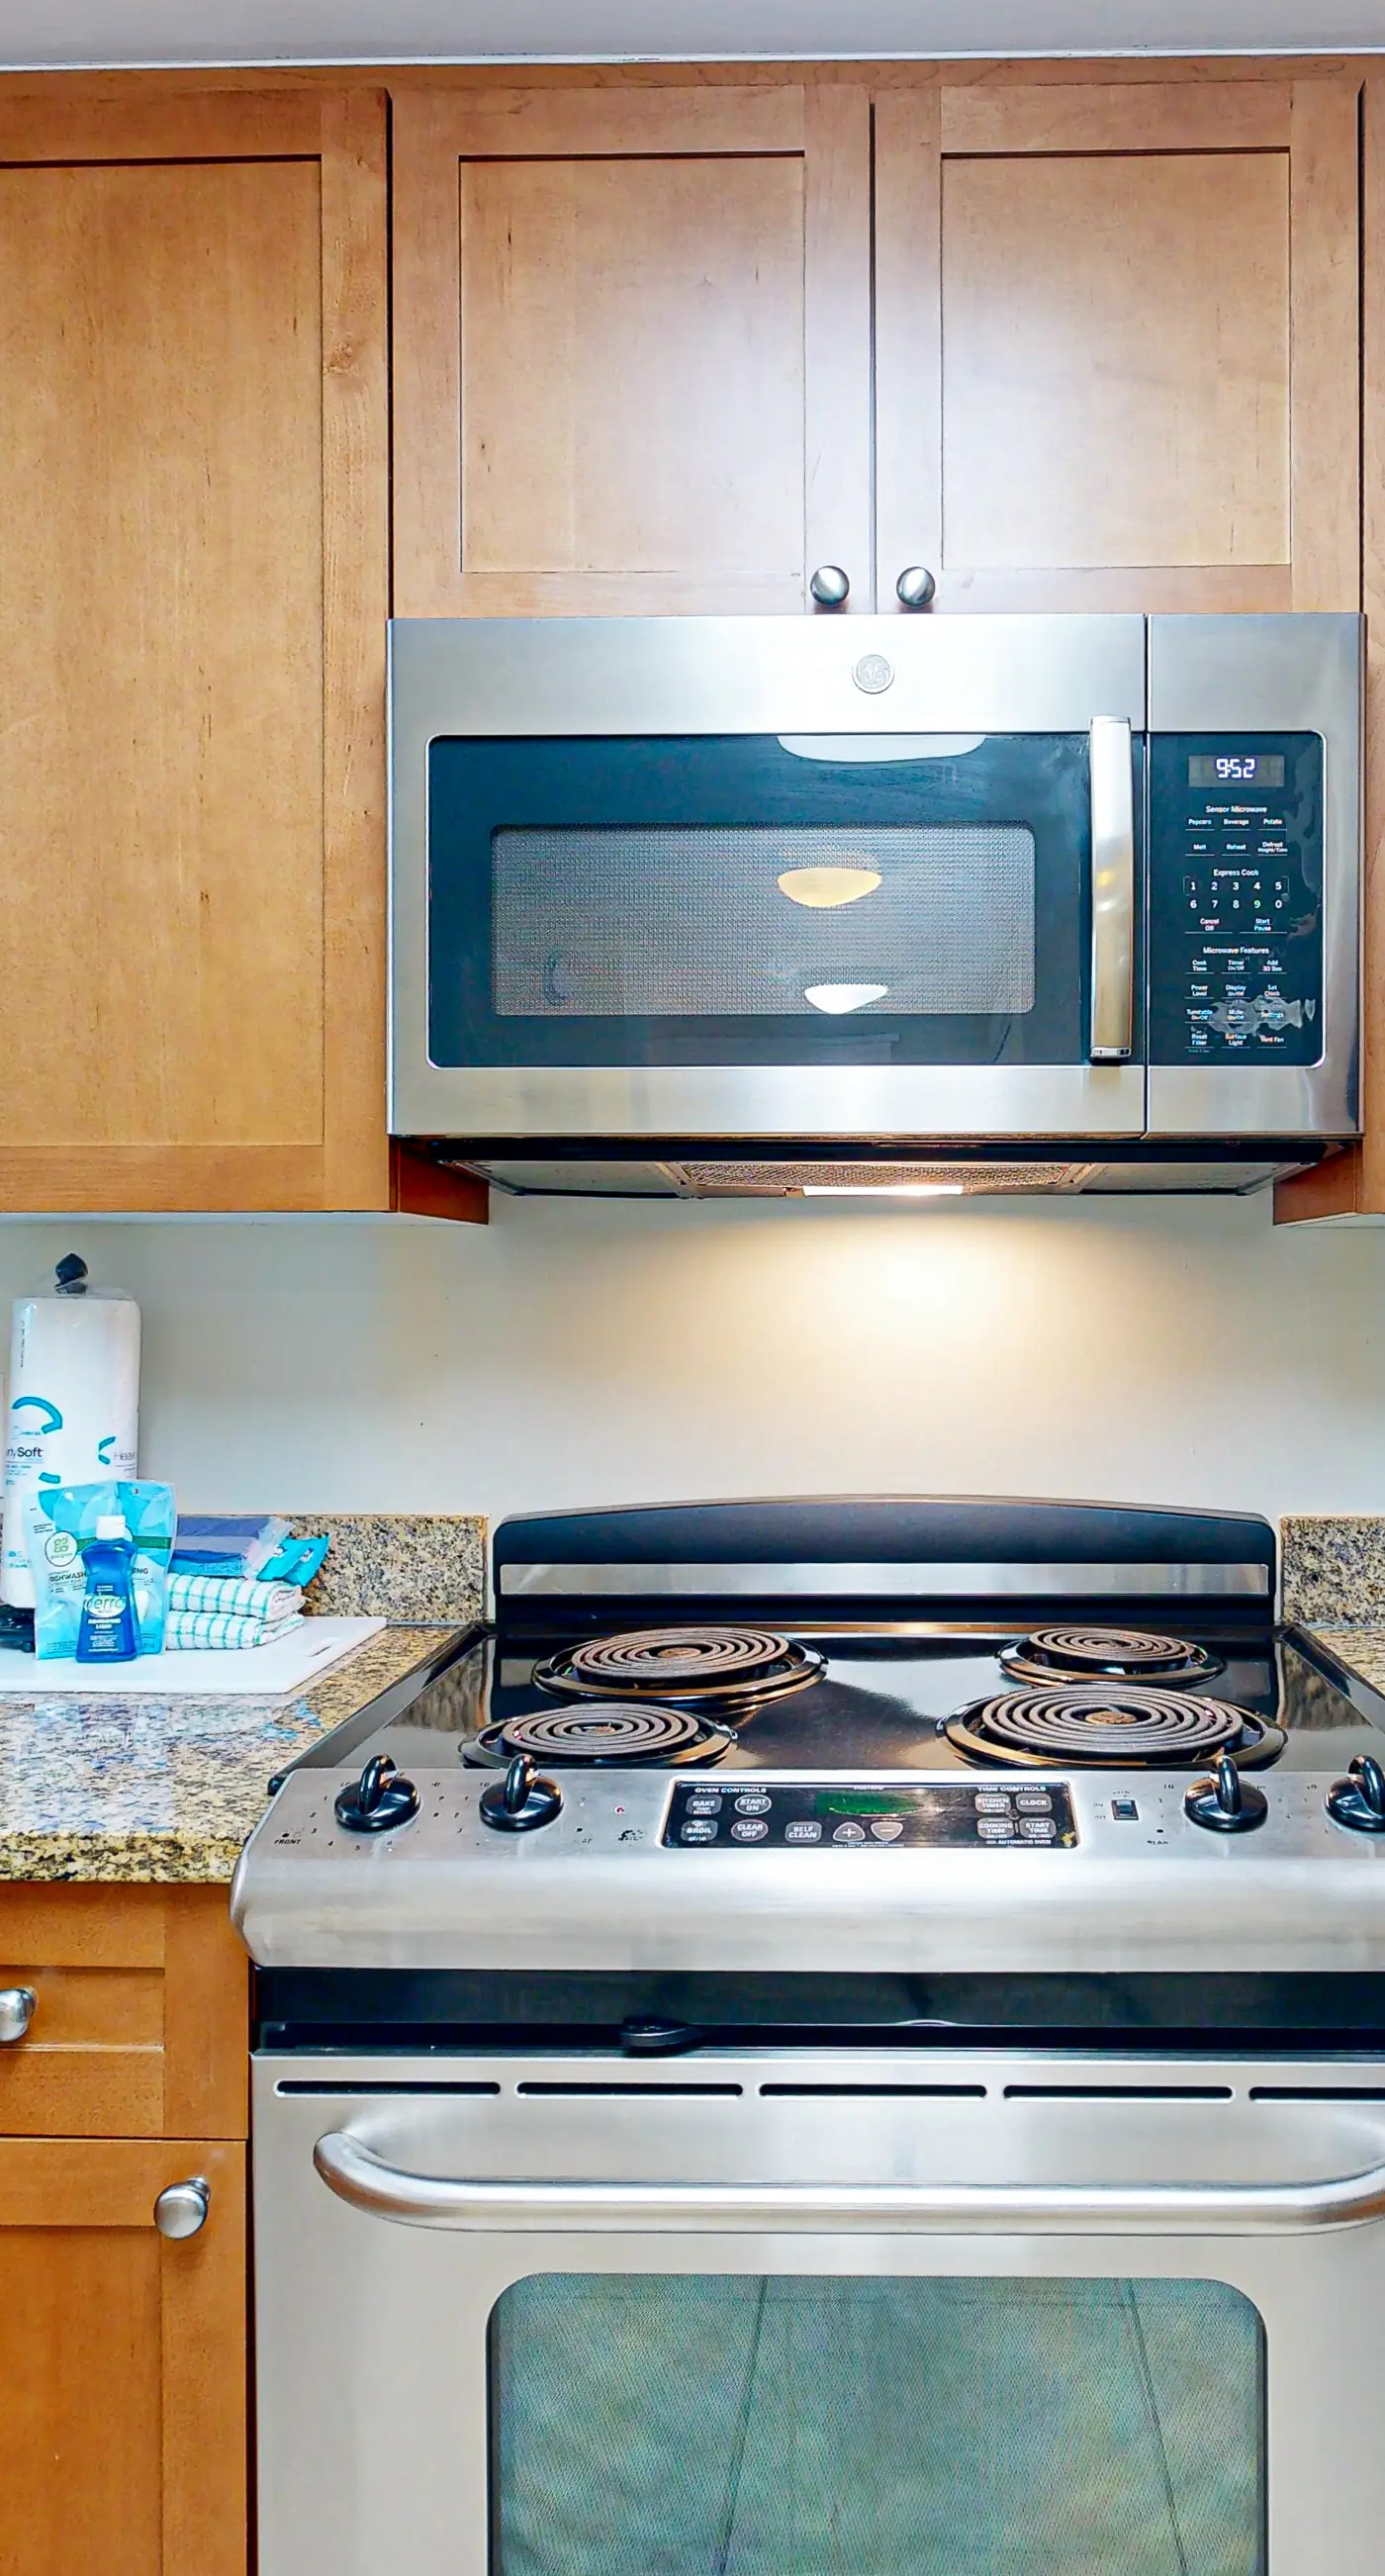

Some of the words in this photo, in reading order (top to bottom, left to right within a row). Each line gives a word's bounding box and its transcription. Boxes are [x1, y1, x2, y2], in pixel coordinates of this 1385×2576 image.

[1216, 758, 1255, 779] 9:52
[1190, 881, 1196, 890] 1
[1211, 881, 1218, 890] 2
[1232, 881, 1240, 890] 3
[1253, 881, 1261, 890] 4
[1274, 881, 1282, 890] 5
[1189, 899, 1197, 908] 6
[1212, 899, 1218, 908] 7
[1233, 899, 1240, 908] 8
[1253, 899, 1261, 908] 9
[1274, 899, 1282, 908] 0
